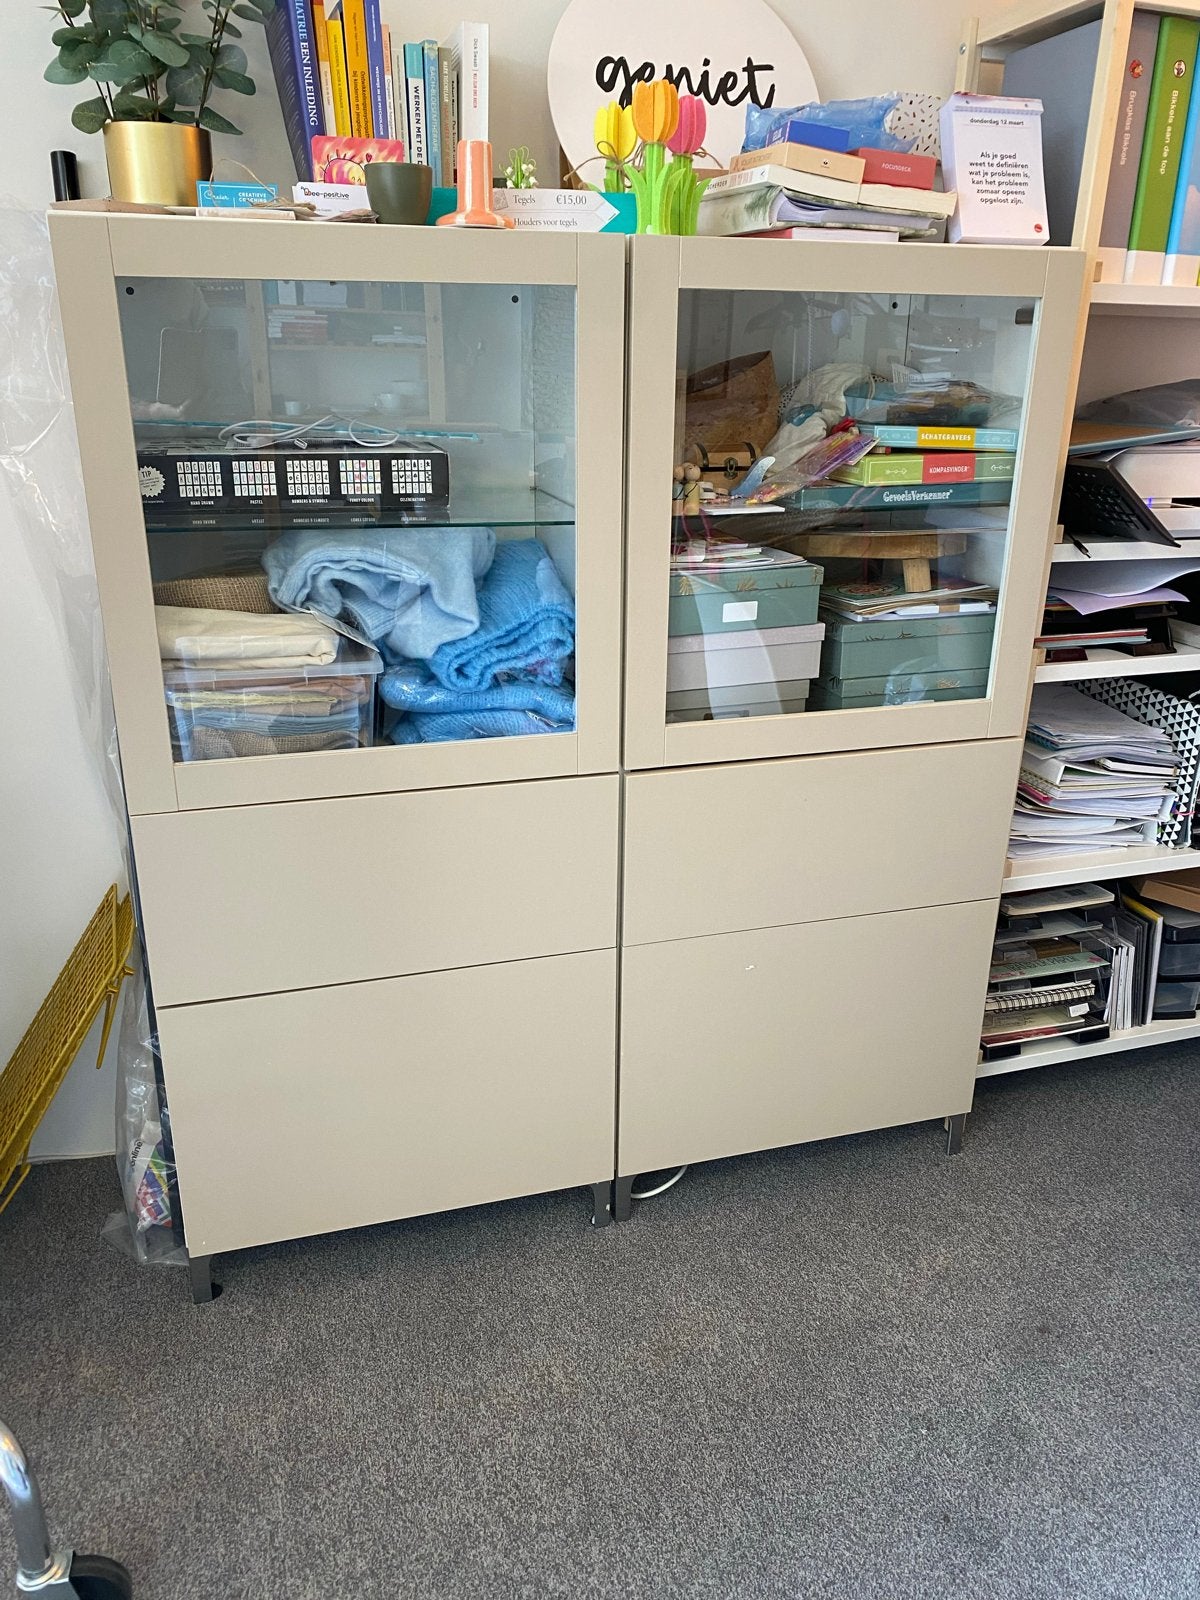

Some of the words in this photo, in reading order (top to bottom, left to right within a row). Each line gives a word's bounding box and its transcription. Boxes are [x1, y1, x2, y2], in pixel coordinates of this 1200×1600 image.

[295, 0, 308, 40] IATRIE
[300, 42, 311, 64] EEN
[595, 56, 776, 110] geniet
[303, 66, 318, 126] INLEIDING
[413, 85, 421, 125] WERKEN
[1168, 90, 1179, 124] Bikkels
[969, 118, 999, 126] donderdag
[1164, 125, 1172, 143] aan
[416, 146, 423, 159] DE
[980, 151, 991, 159] Als
[992, 152, 999, 160] je
[1120, 133, 1131, 166] Bikkels
[1162, 145, 1170, 158] de
[995, 161, 1029, 169] definiëren
[1160, 159, 1168, 175] top
[982, 170, 989, 178] je
[513, 194, 536, 204] Tegels
[556, 194, 587, 206] €15,00
[980, 197, 1009, 205] opgelost
[1010, 197, 1024, 205] zijn.
[513, 217, 542, 226] Houders
[559, 219, 578, 228] tegels
[920, 433, 972, 442] SCHATGRAVERS
[142, 470, 152, 478] TIP
[929, 465, 968, 474] KOMPASVINDER
